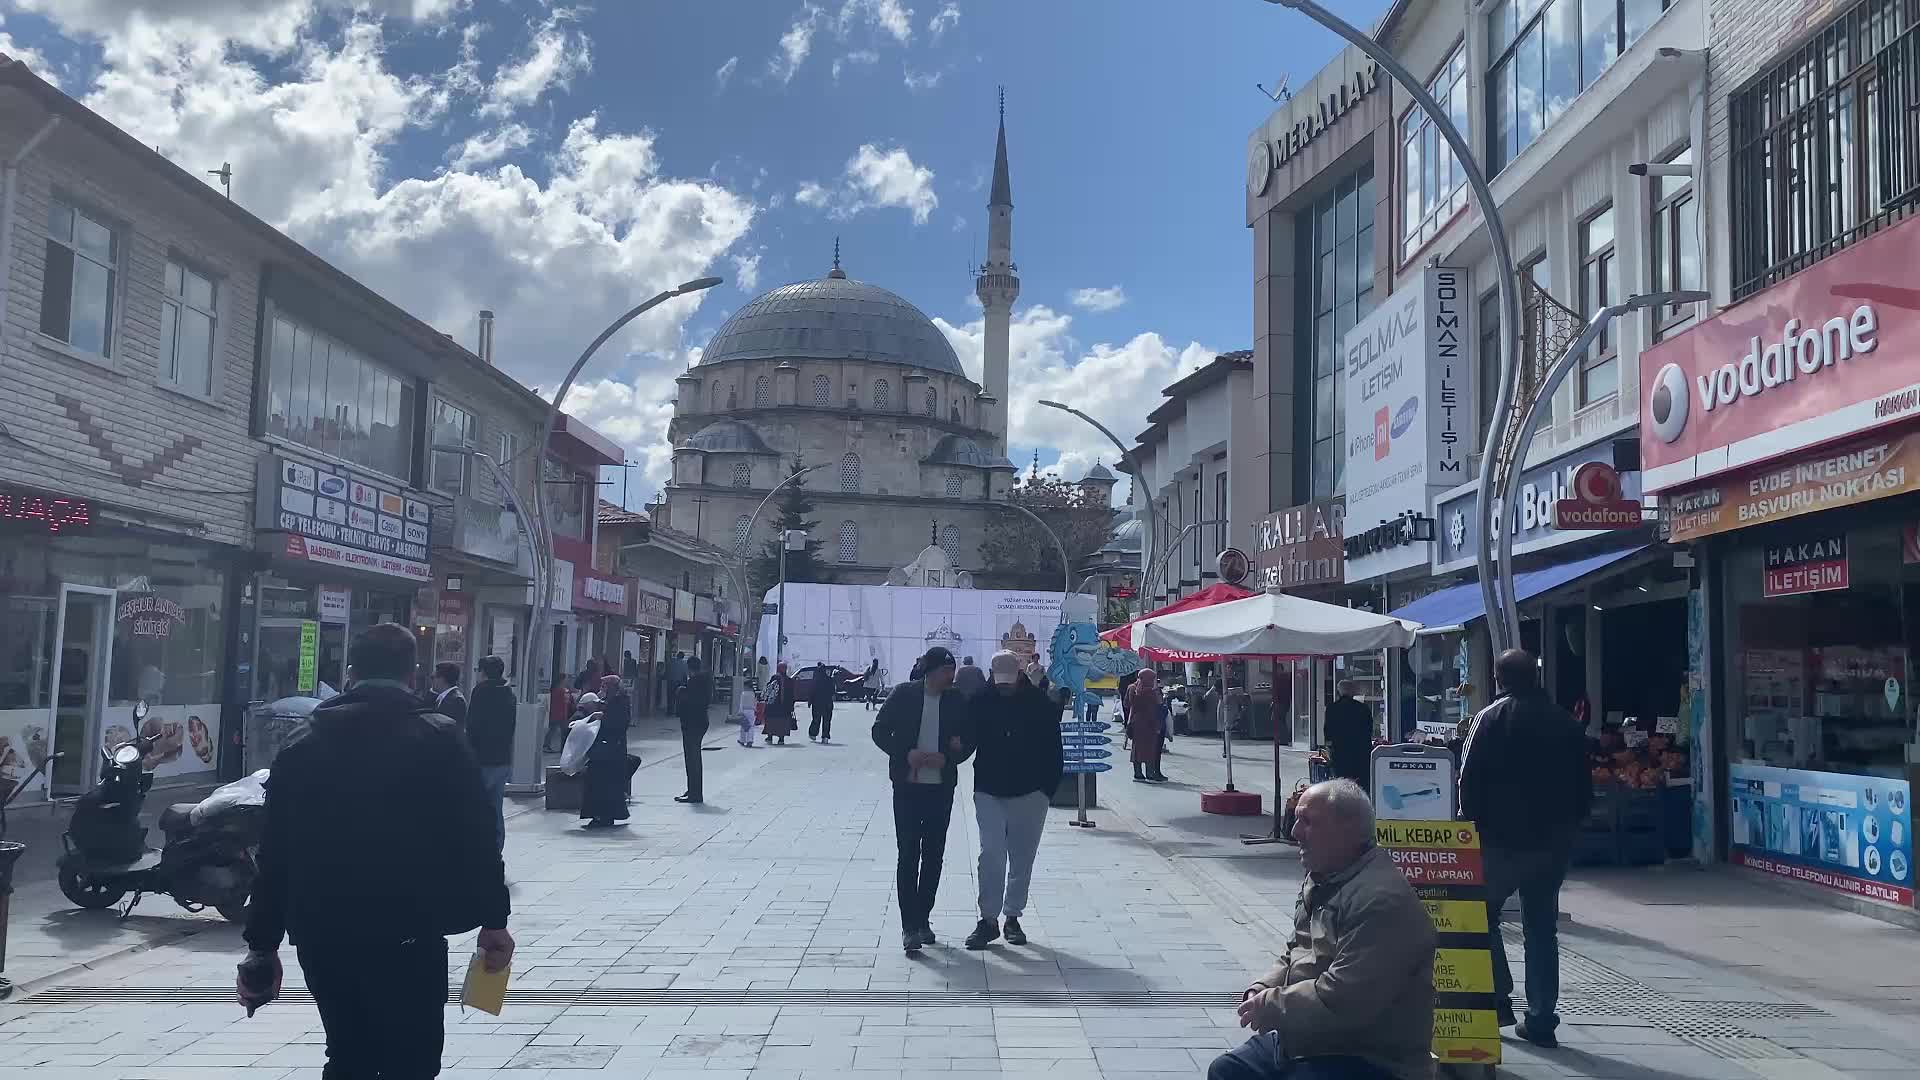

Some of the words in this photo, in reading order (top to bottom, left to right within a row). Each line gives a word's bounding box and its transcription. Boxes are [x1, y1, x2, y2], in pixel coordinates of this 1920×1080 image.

[1272, 60, 1377, 170] MERALLAR
[1437, 273, 1459, 358] SOLMAZ
[1349, 296, 1418, 378] SOLMAZ
[1697, 304, 1879, 412] vodafone
[1738, 491, 1815, 522] BAŞVURU
[1820, 466, 1905, 502] NOKTASI
[1750, 470, 1792, 497] EVDE
[1561, 507, 1639, 524] vodafone
[1676, 491, 1720, 514] HAKAN
[280, 512, 296, 530] CEP
[407, 527, 426, 540] SONY
[1769, 538, 1842, 567] HAKAN
[1769, 564, 1842, 591] İLETİŞİM
[1393, 762, 1434, 770] HAKAN
[1405, 827, 1453, 844] KEBAP
[1426, 869, 1474, 881] (YAPRAK)
[1766, 863, 1775, 872] EL
[1776, 864, 1791, 875] CEP
[1791, 867, 1832, 885] TELEFONU
[1833, 877, 1861, 893] ALINIR
[1865, 885, 1900, 902] SATILIR
